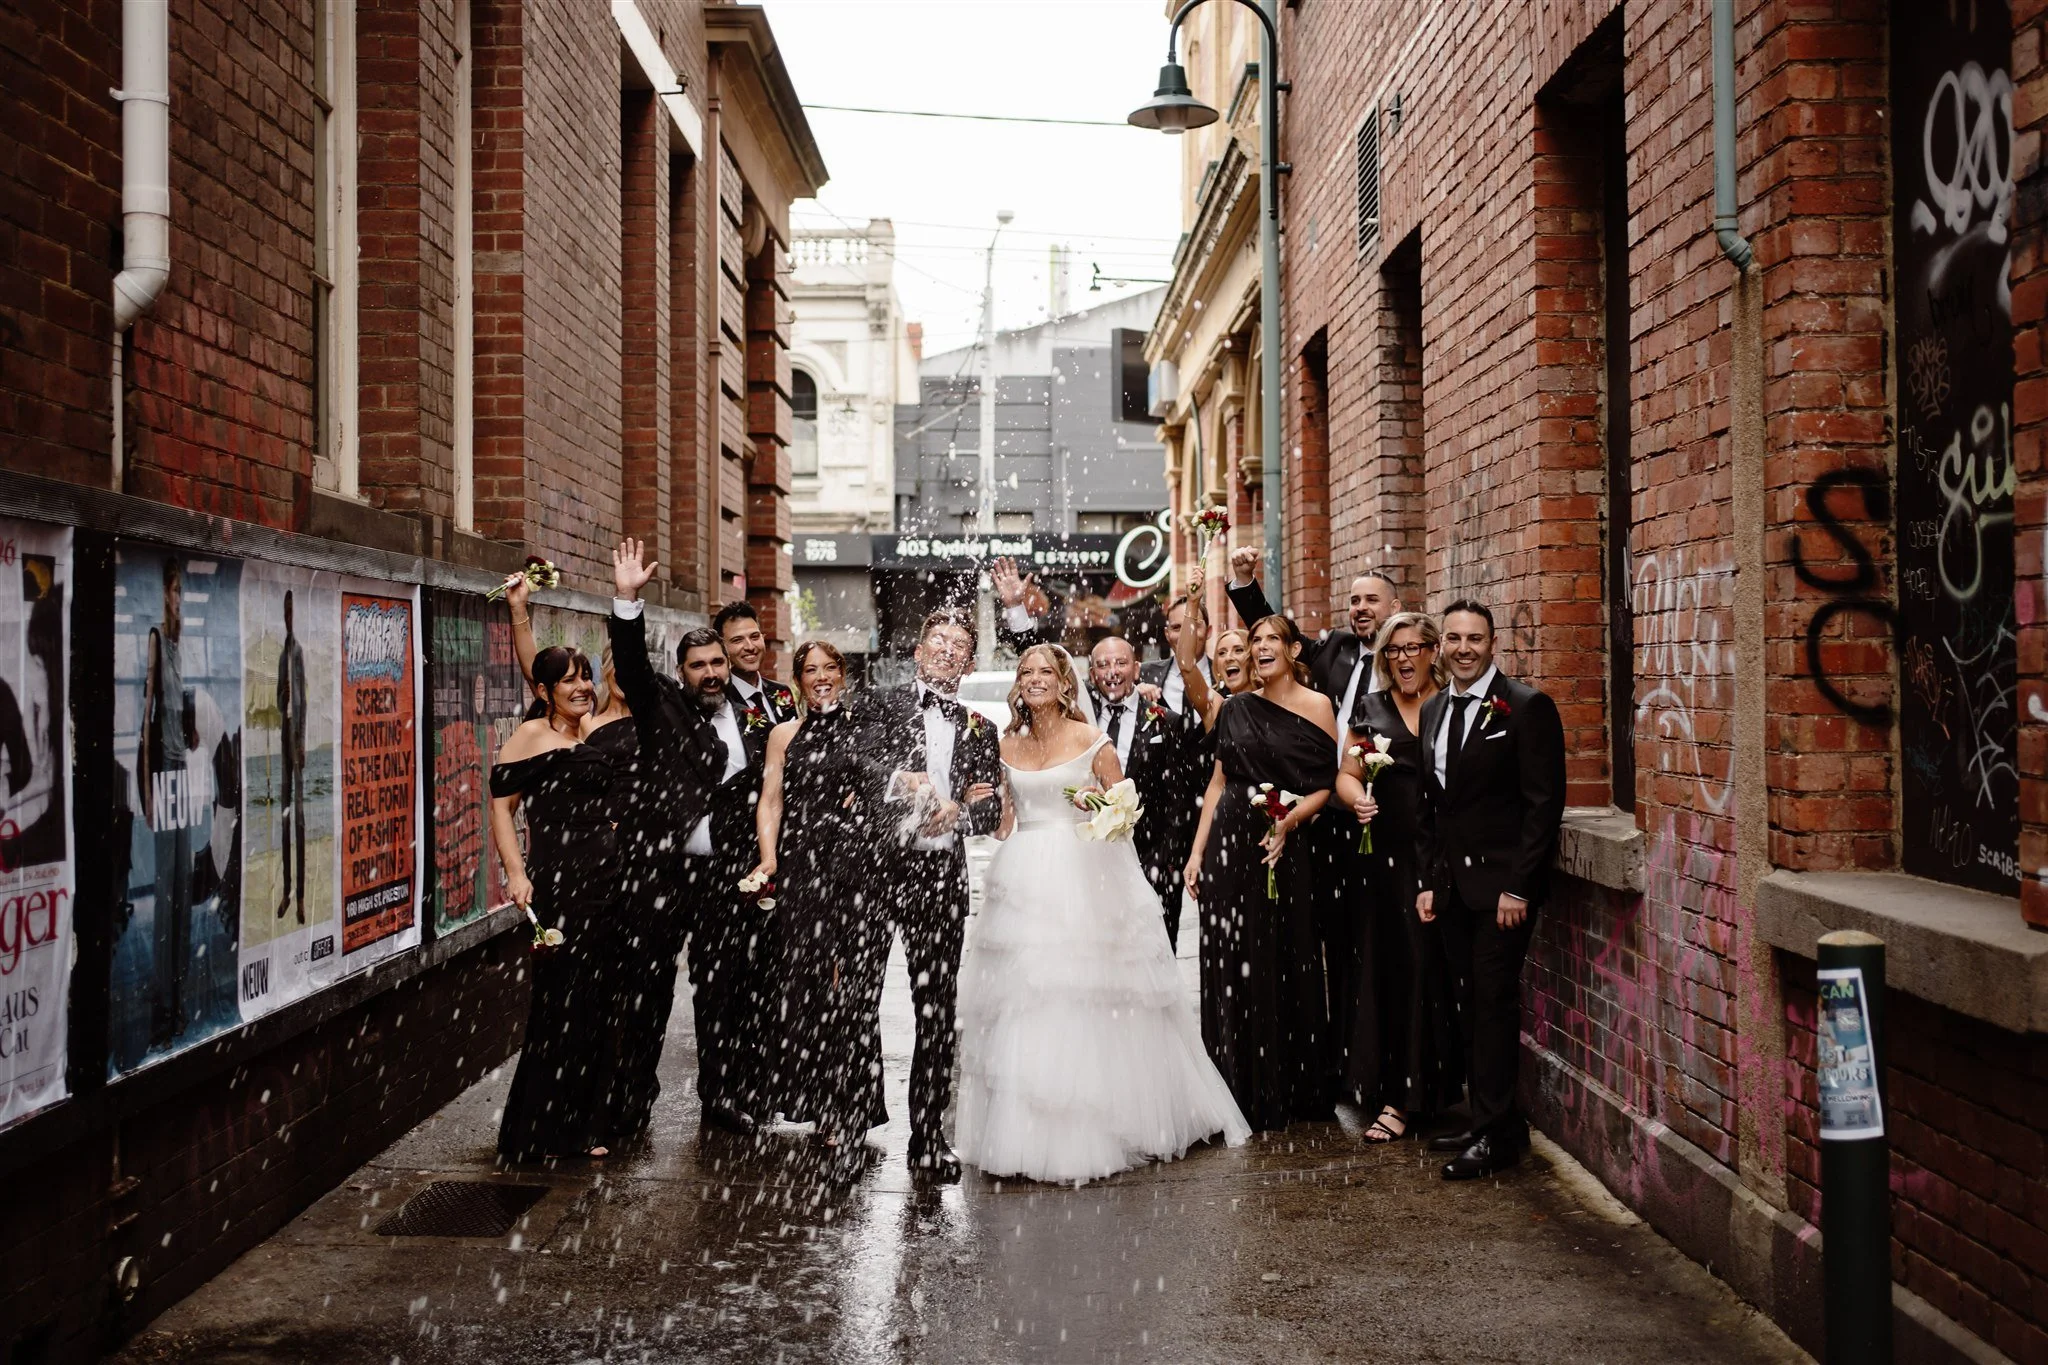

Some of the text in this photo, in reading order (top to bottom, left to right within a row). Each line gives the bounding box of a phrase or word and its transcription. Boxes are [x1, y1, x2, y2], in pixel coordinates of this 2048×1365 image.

[805, 548, 837, 561] 1978
[895, 539, 1032, 560] 403 Sydney Road
[356, 687, 397, 716] SCREEN
[352, 719, 402, 750] PRINTING
[344, 750, 411, 786] IS THE ONLY
[152, 769, 204, 833] NEUW
[347, 782, 409, 820] REAL FORM
[349, 815, 407, 855] OF T-SHIRT
[242, 957, 269, 1002] NEUW
